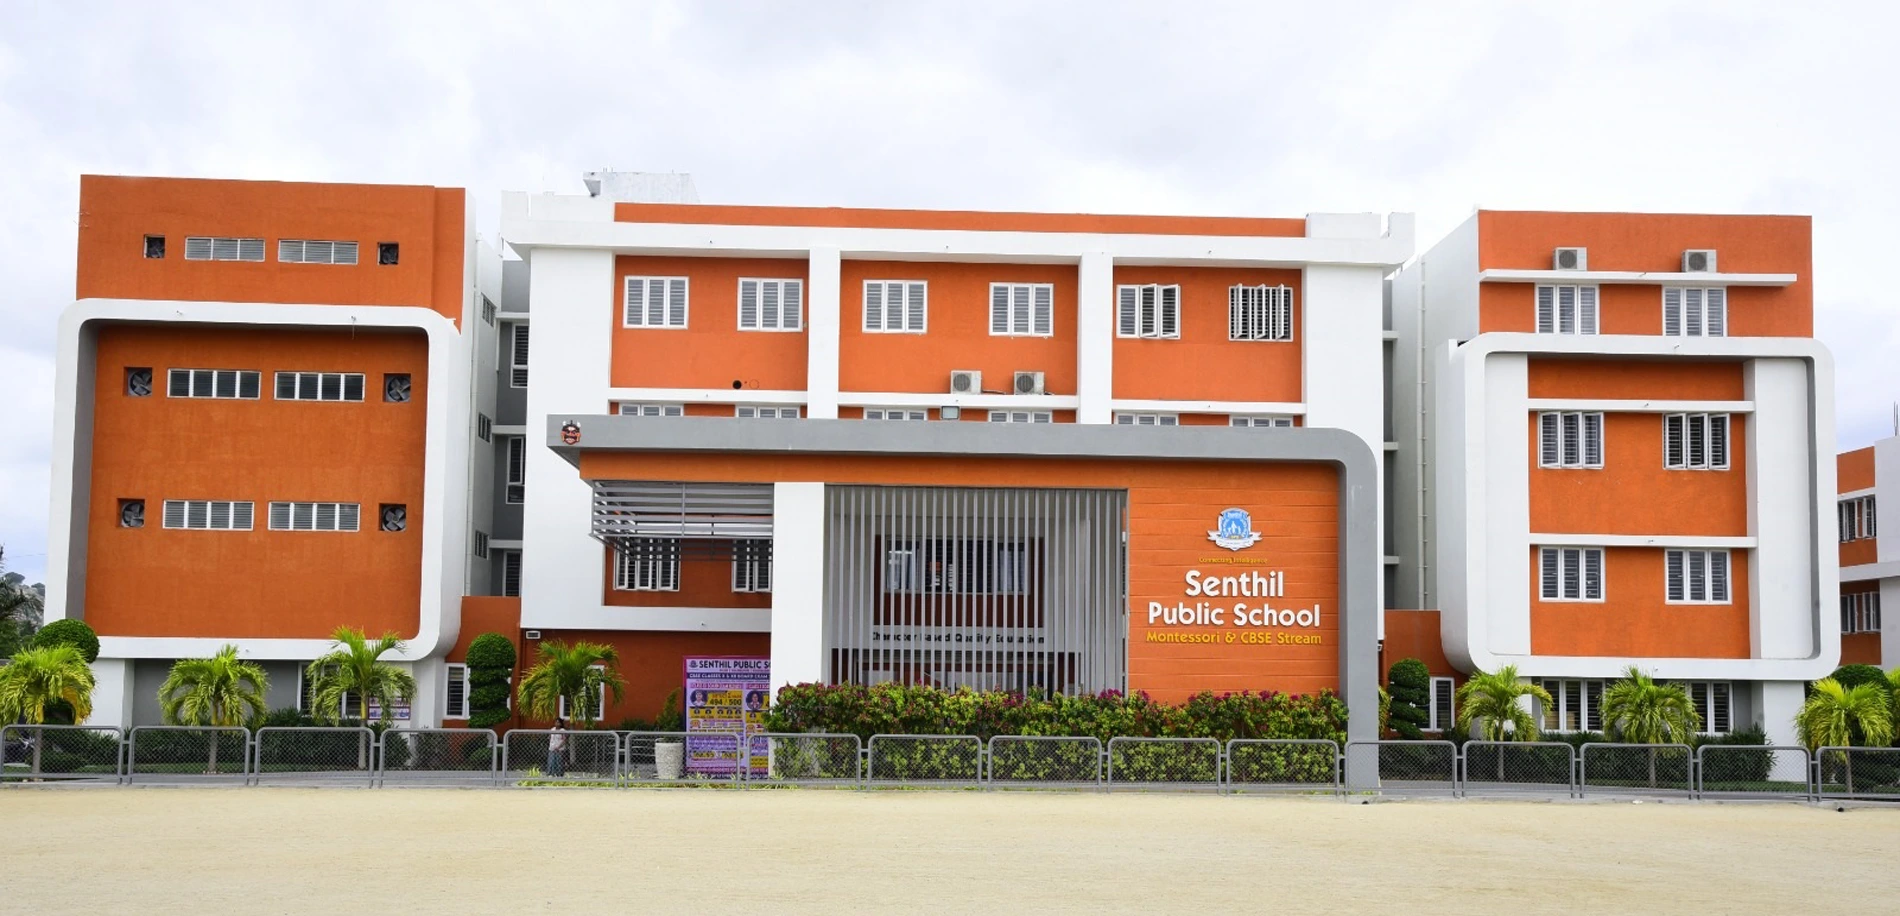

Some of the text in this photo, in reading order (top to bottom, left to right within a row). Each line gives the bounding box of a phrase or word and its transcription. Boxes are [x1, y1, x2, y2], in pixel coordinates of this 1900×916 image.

[1184, 570, 1284, 597] Senthil
[1148, 602, 1320, 627] Public School
[871, 631, 917, 641] Charcer
[955, 633, 991, 644] Qaity
[996, 633, 1044, 643] Euaion
[1146, 632, 1322, 644] Montessori & CBSE Stream
[699, 660, 732, 668] SENTHIL
[733, 660, 761, 668] PUBLIC
